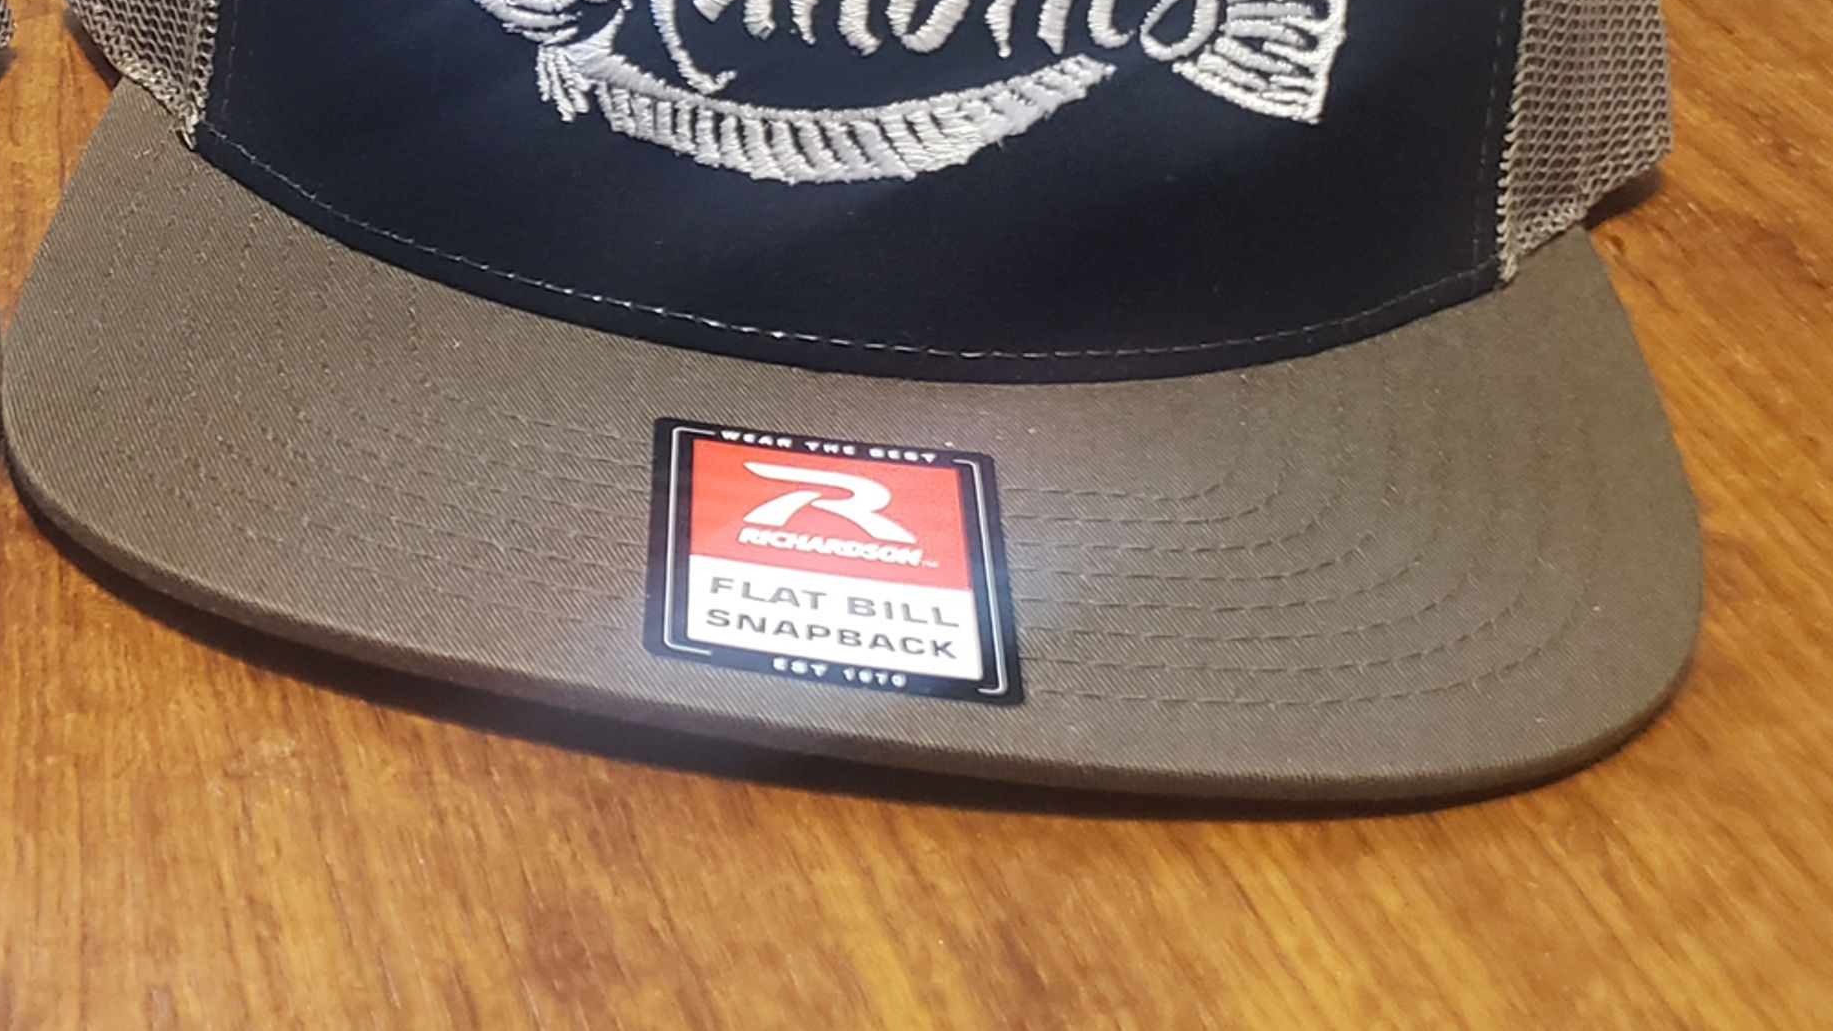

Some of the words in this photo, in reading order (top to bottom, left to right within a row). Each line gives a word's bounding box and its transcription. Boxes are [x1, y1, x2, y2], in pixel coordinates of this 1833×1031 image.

[721, 430, 793, 448] WEAR
[805, 441, 856, 456] THE
[869, 447, 936, 463] BEST
[737, 526, 923, 567] RICHARDSON
[710, 576, 827, 610] FLAT
[846, 596, 960, 628] BILL
[706, 608, 957, 659] SNAPBACK
[773, 657, 828, 678] EST
